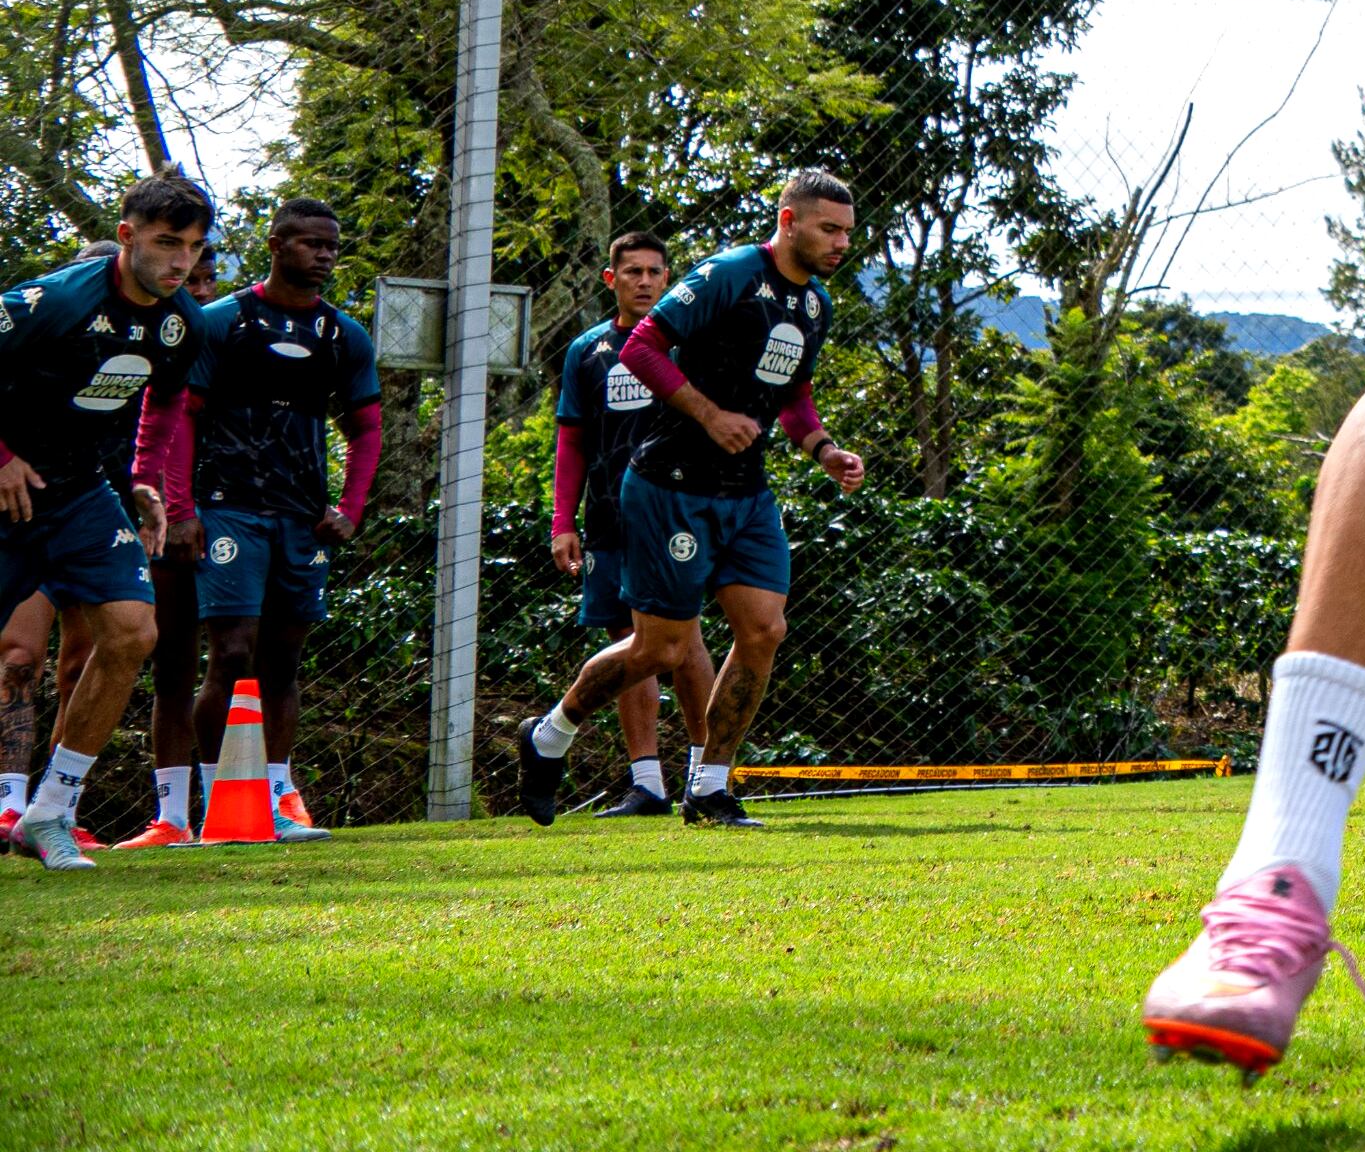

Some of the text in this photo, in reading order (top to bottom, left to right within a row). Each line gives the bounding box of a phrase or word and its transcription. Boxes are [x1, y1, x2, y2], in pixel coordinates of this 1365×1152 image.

[129, 326, 143, 341] 30
[766, 339, 803, 359] BURGER
[758, 352, 800, 375] KING
[91, 373, 148, 388] BURGER
[608, 374, 641, 387] BURG
[76, 385, 140, 399] KING
[608, 384, 653, 402] KING
